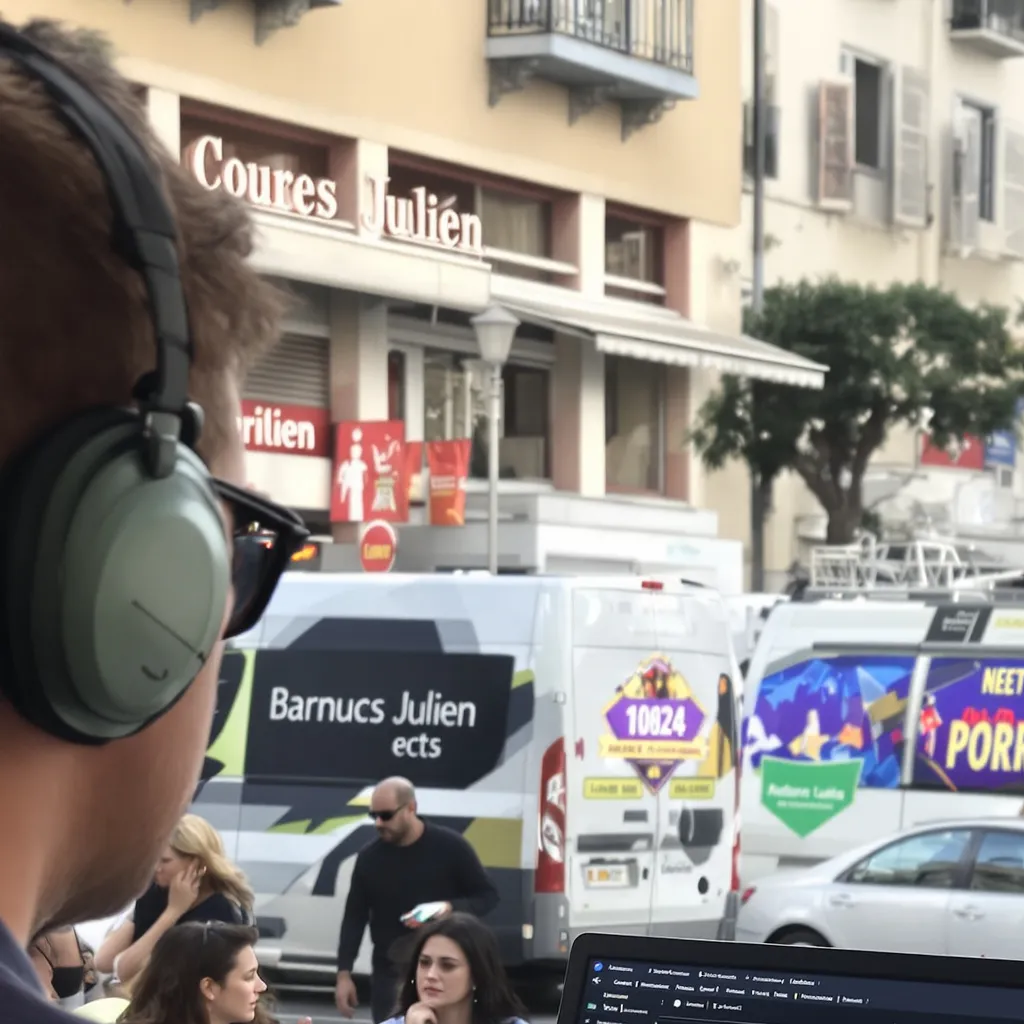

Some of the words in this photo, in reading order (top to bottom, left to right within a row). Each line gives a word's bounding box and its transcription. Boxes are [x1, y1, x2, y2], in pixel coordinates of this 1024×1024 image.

[193, 135, 338, 220] Coures
[235, 405, 316, 450] rilien
[269, 686, 386, 725] Barnucs
[392, 689, 477, 728] Julien
[392, 732, 442, 758] ects
